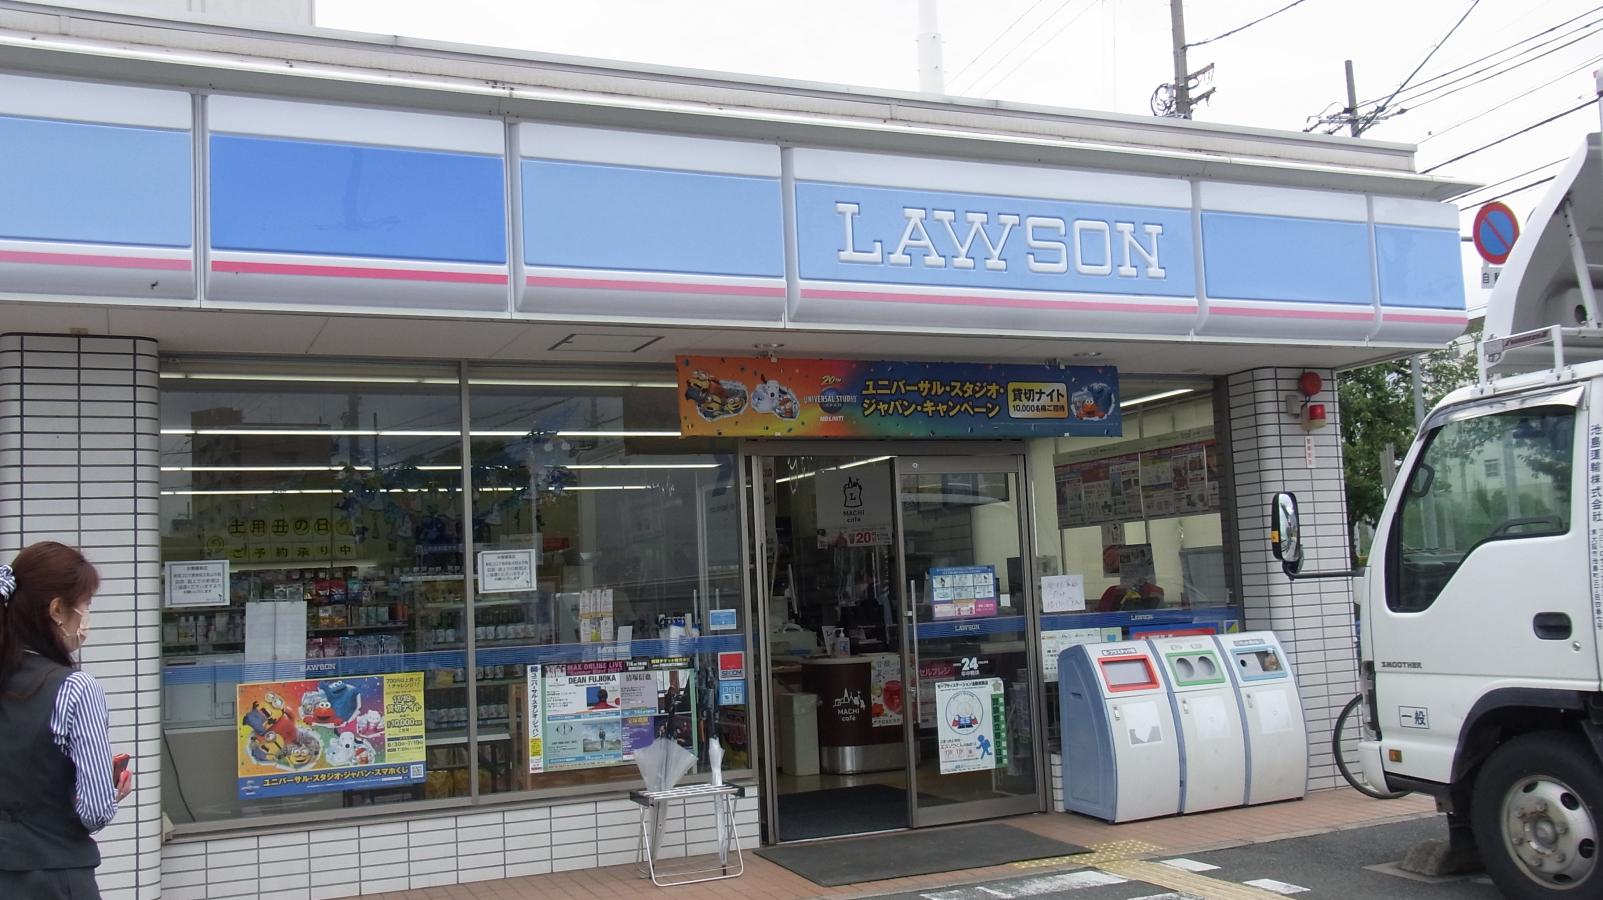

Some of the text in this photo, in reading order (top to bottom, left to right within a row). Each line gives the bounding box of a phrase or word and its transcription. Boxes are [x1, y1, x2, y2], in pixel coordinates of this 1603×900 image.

[834, 200, 1168, 279] LAWSON
[1011, 388, 1065, 402] 貸切ナイト
[862, 399, 1001, 419] ジャパン・キャンペーン
[228, 518, 330, 535] 土用丑の日
[231, 544, 352, 559] ご予約承り中
[608, 660, 623, 669] LIVE
[961, 656, 979, 671] 24
[1381, 661, 1422, 669] SMOOTHER
[568, 676, 587, 684] DEAN
[588, 674, 617, 684] FUJIOKA
[1401, 710, 1426, 726] 一般
